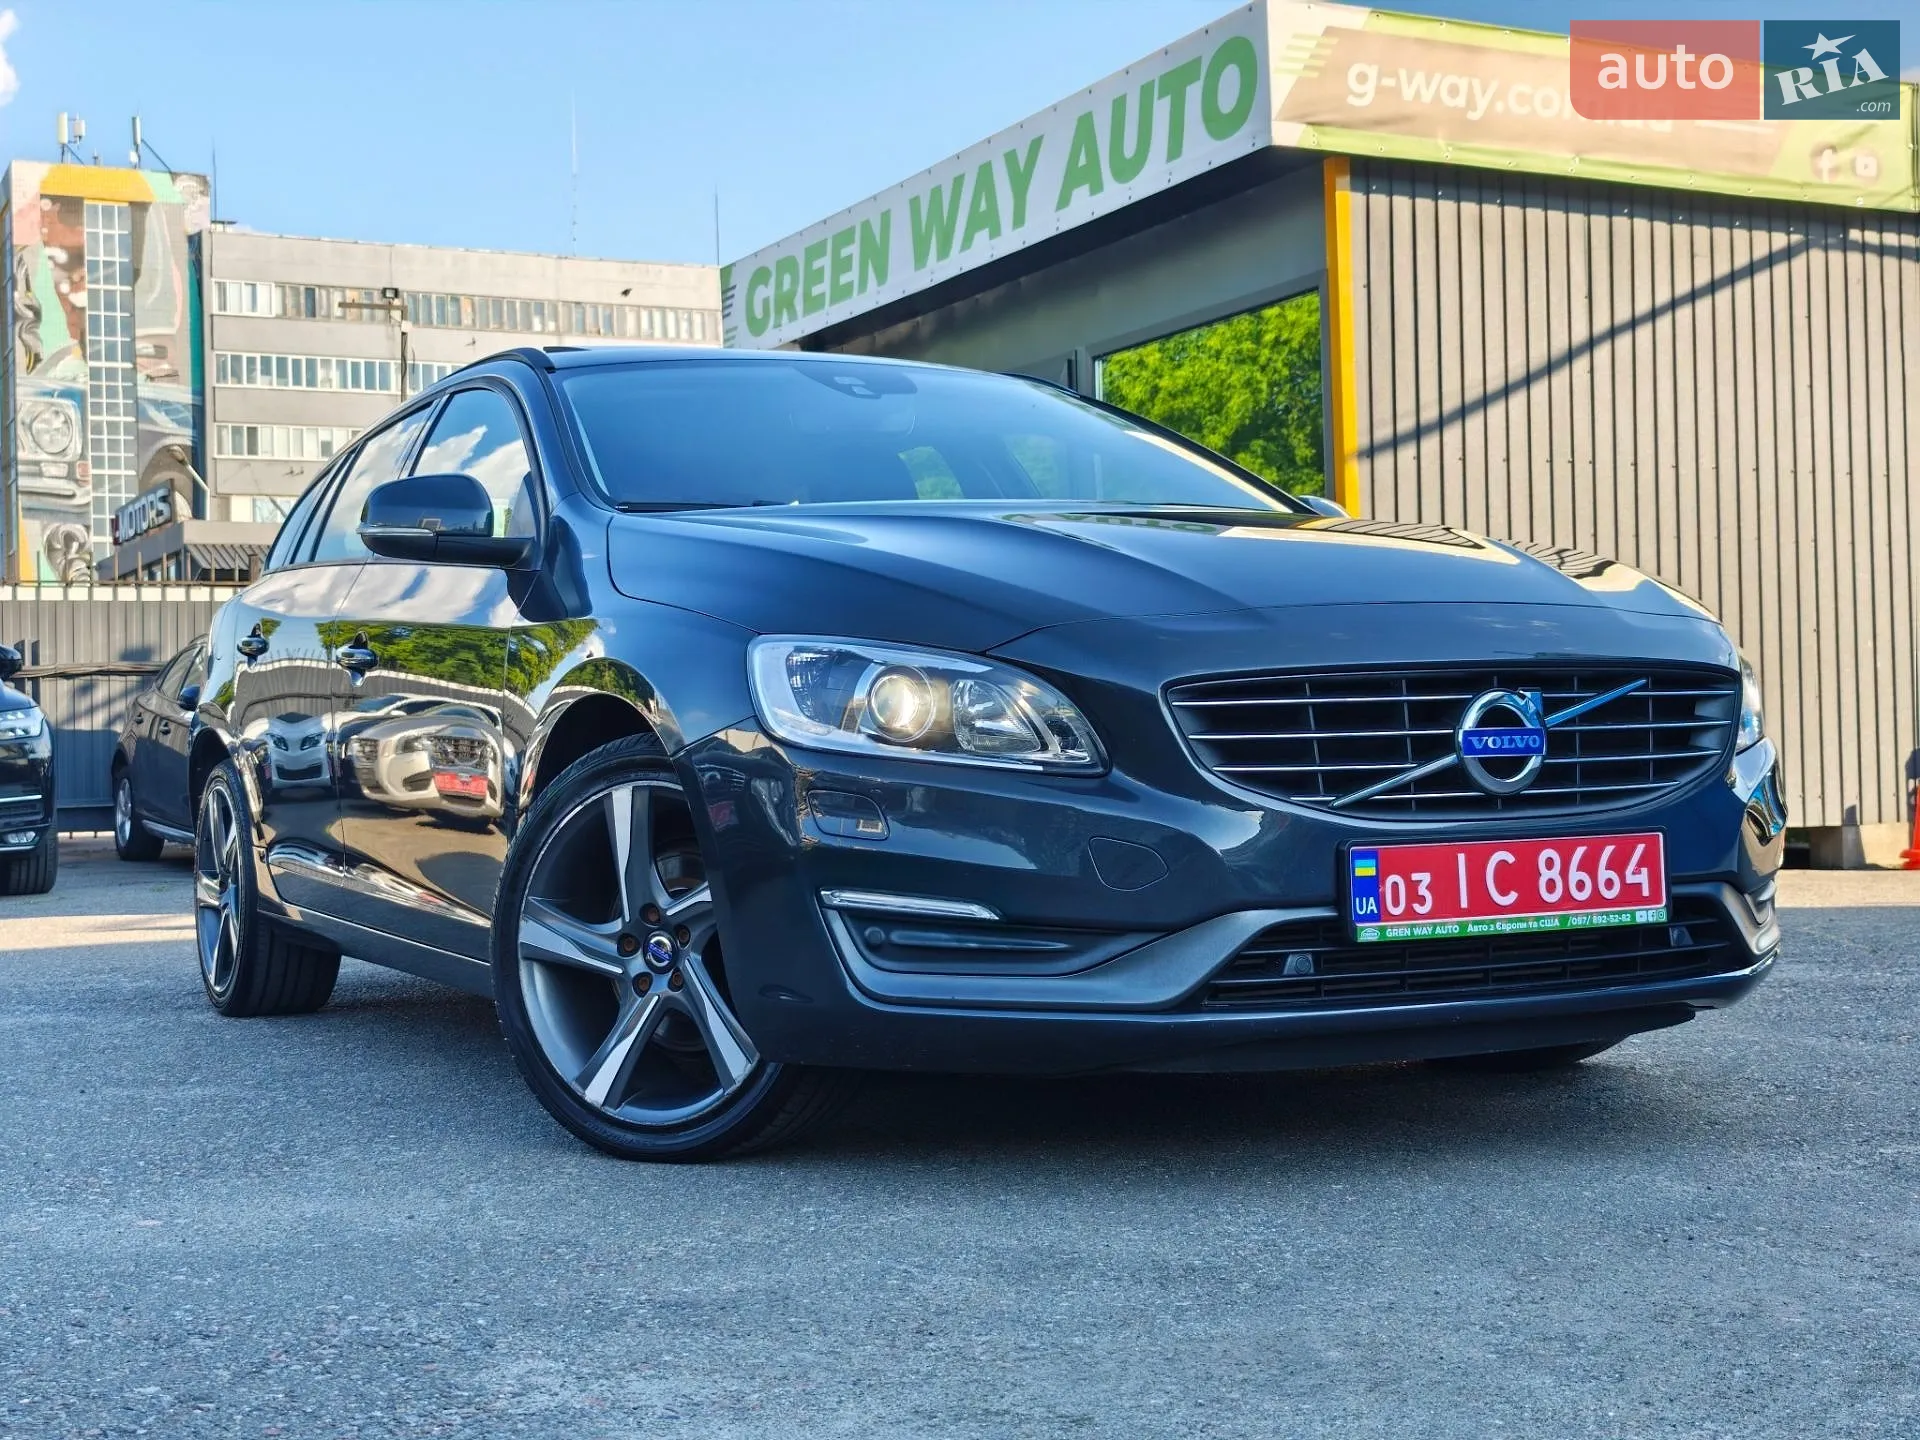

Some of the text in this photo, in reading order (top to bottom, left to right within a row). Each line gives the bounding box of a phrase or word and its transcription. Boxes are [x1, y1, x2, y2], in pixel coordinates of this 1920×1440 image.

[745, 36, 1258, 338] GREEN WAY AUTO
[1468, 735, 1540, 749] VOLVO
[1385, 873, 1433, 916] 03
[1538, 843, 1650, 903] 8664
[1355, 896, 1378, 915] UA
[1386, 928, 1411, 937] GREN
[1413, 926, 1433, 936] WAY
[1435, 925, 1459, 935] AUTO
[1467, 923, 1488, 932] Авто
